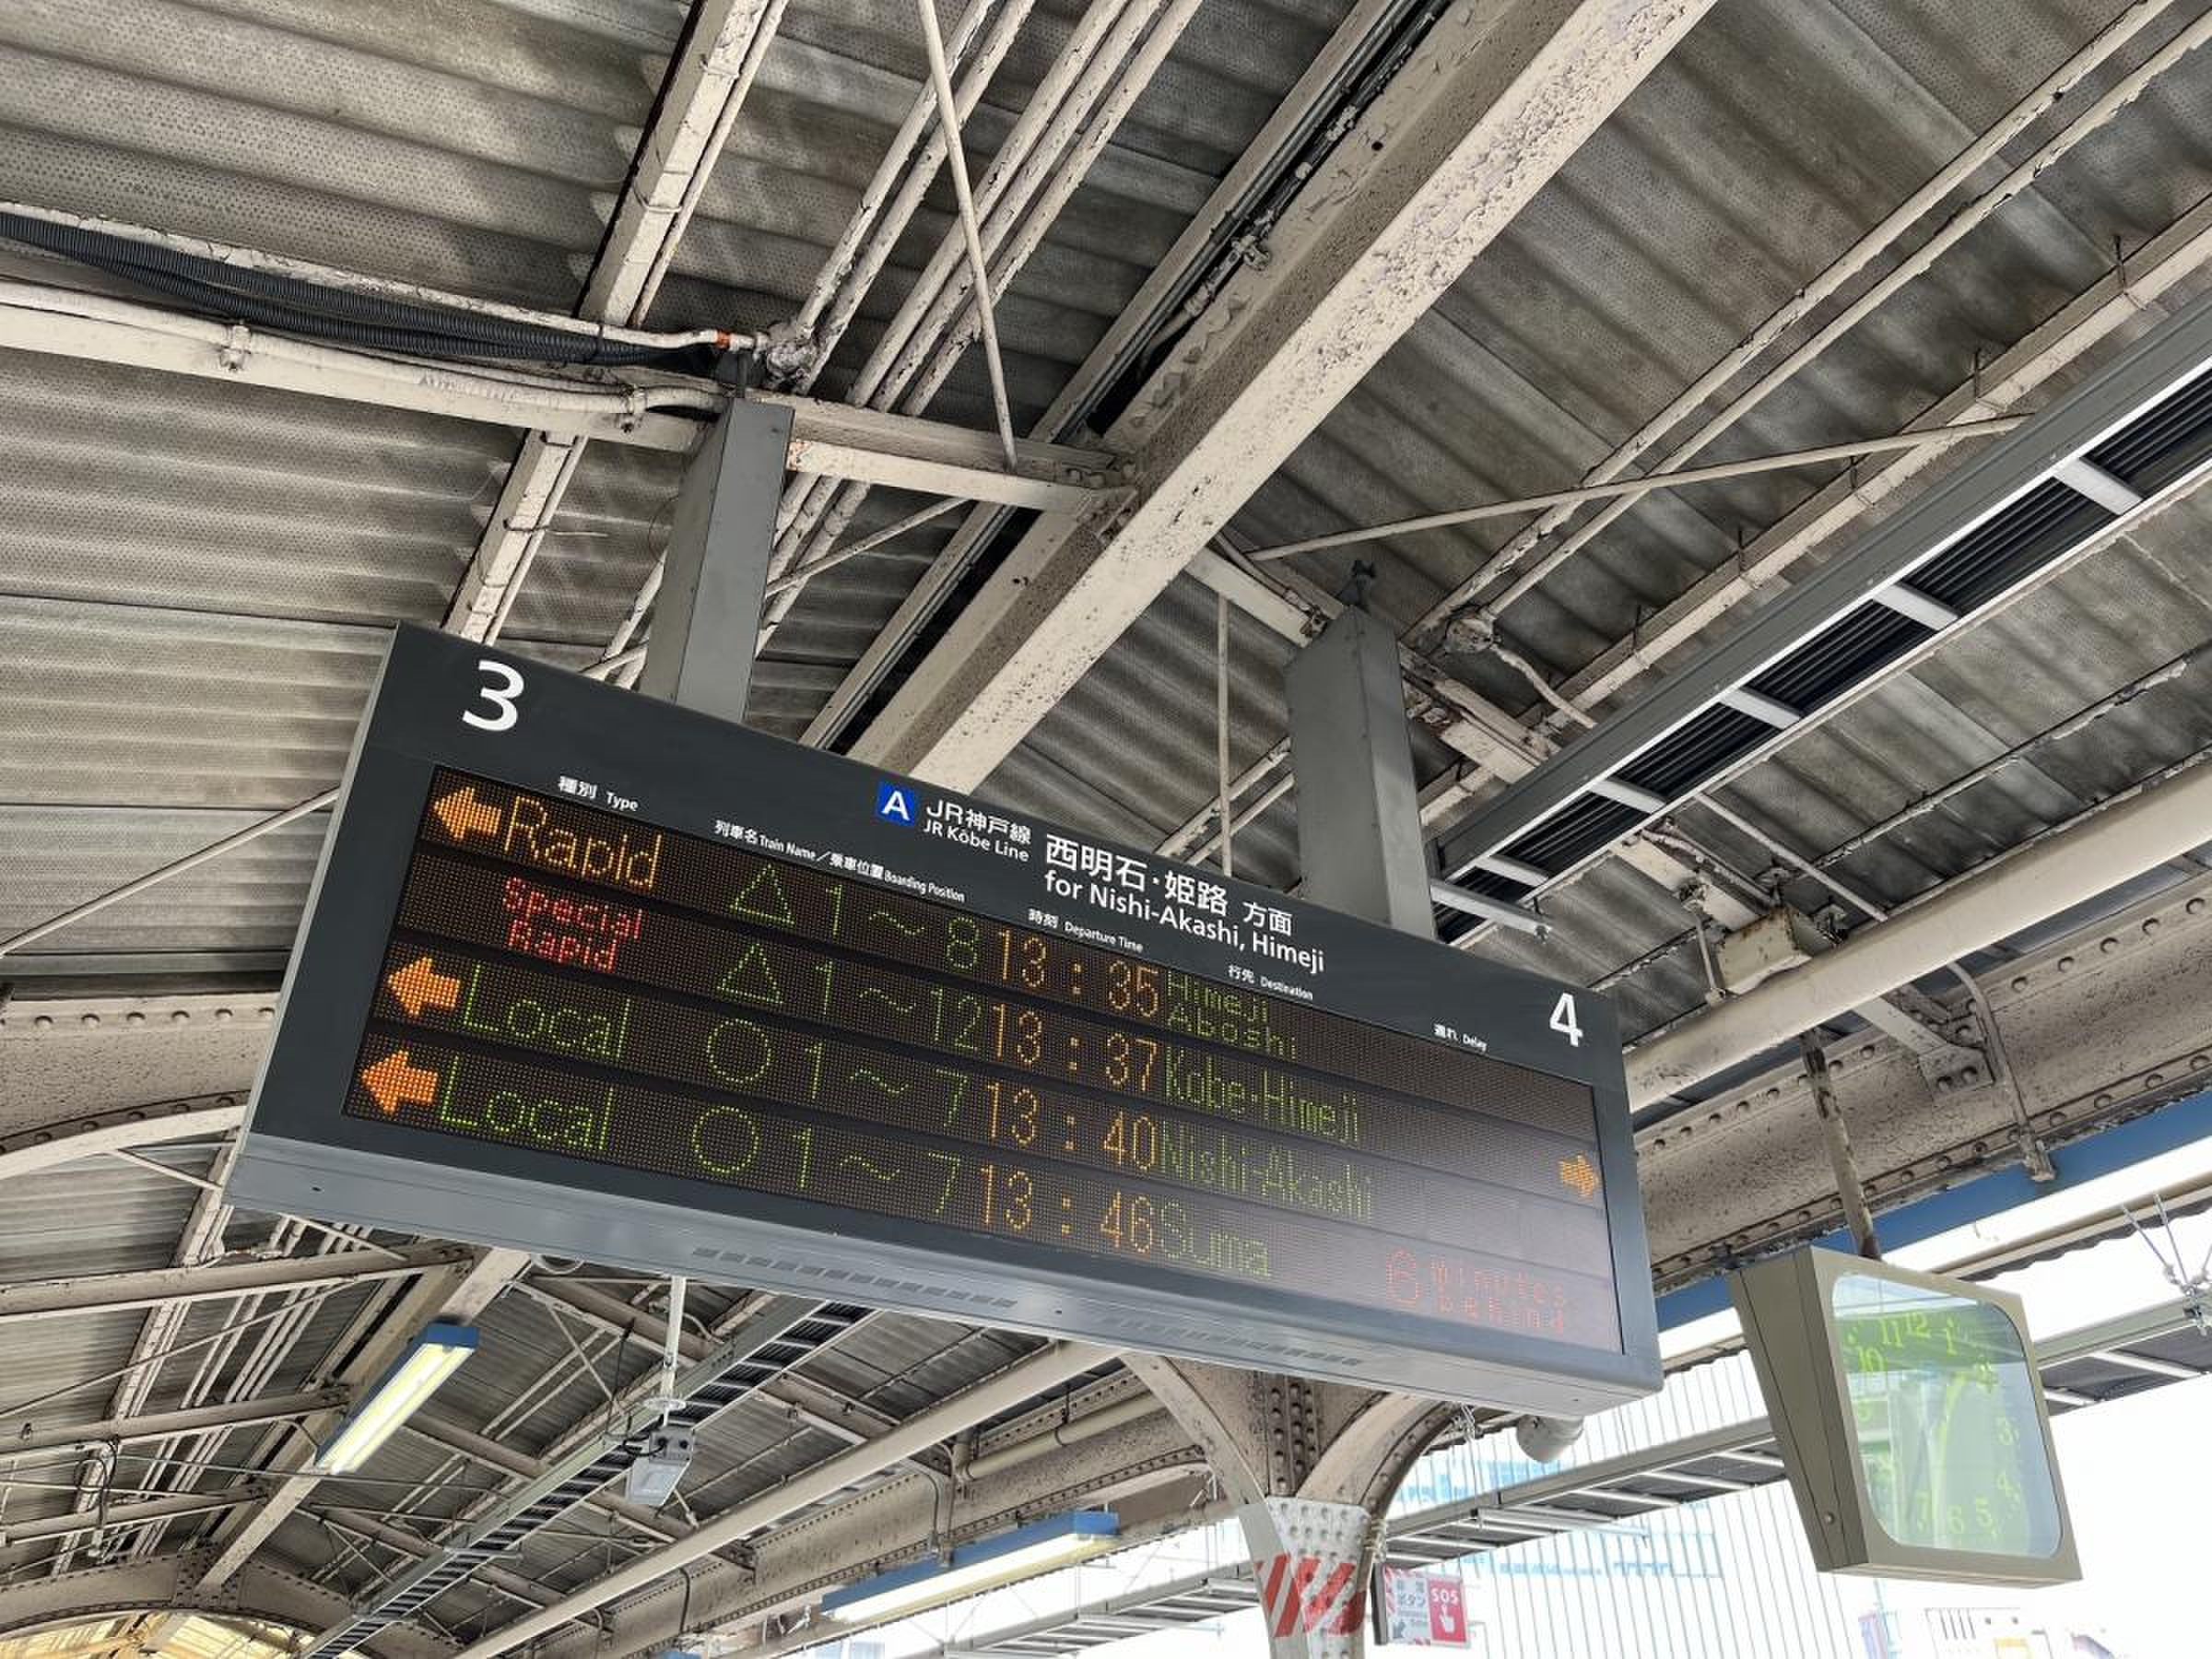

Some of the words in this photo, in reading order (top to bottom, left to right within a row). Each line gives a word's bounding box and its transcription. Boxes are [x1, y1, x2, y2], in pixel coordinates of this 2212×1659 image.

[462, 661, 525, 732] 3
[606, 791, 639, 811] Type
[882, 791, 910, 821] A
[926, 799, 1031, 845] JR神戸線
[924, 819, 943, 837] JR
[994, 840, 1030, 862] Line
[759, 834, 784, 853] Train
[785, 841, 817, 862] Name
[884, 869, 926, 895] Boarding
[928, 882, 965, 903] Position
[502, 877, 643, 940] Special
[505, 795, 662, 889] Rapid
[1167, 970, 1267, 1023] Himeji
[1044, 870, 1083, 900] for
[1090, 882, 1245, 952] Nishi-Akashi,
[1253, 931, 1324, 974] Himeji
[1243, 900, 1292, 937] 方面
[509, 918, 618, 971] Rapid
[1065, 921, 1117, 945] Departure
[1118, 935, 1143, 953] Time
[1260, 976, 1313, 1001] Destination
[1549, 993, 1583, 1047] 4
[462, 963, 632, 1060] Local
[1160, 1117, 1371, 1225] Nishi-Akashi
[440, 1054, 615, 1151] Local
[1159, 1200, 1271, 1278] Suma
[1430, 1588, 1459, 1605] SOS
